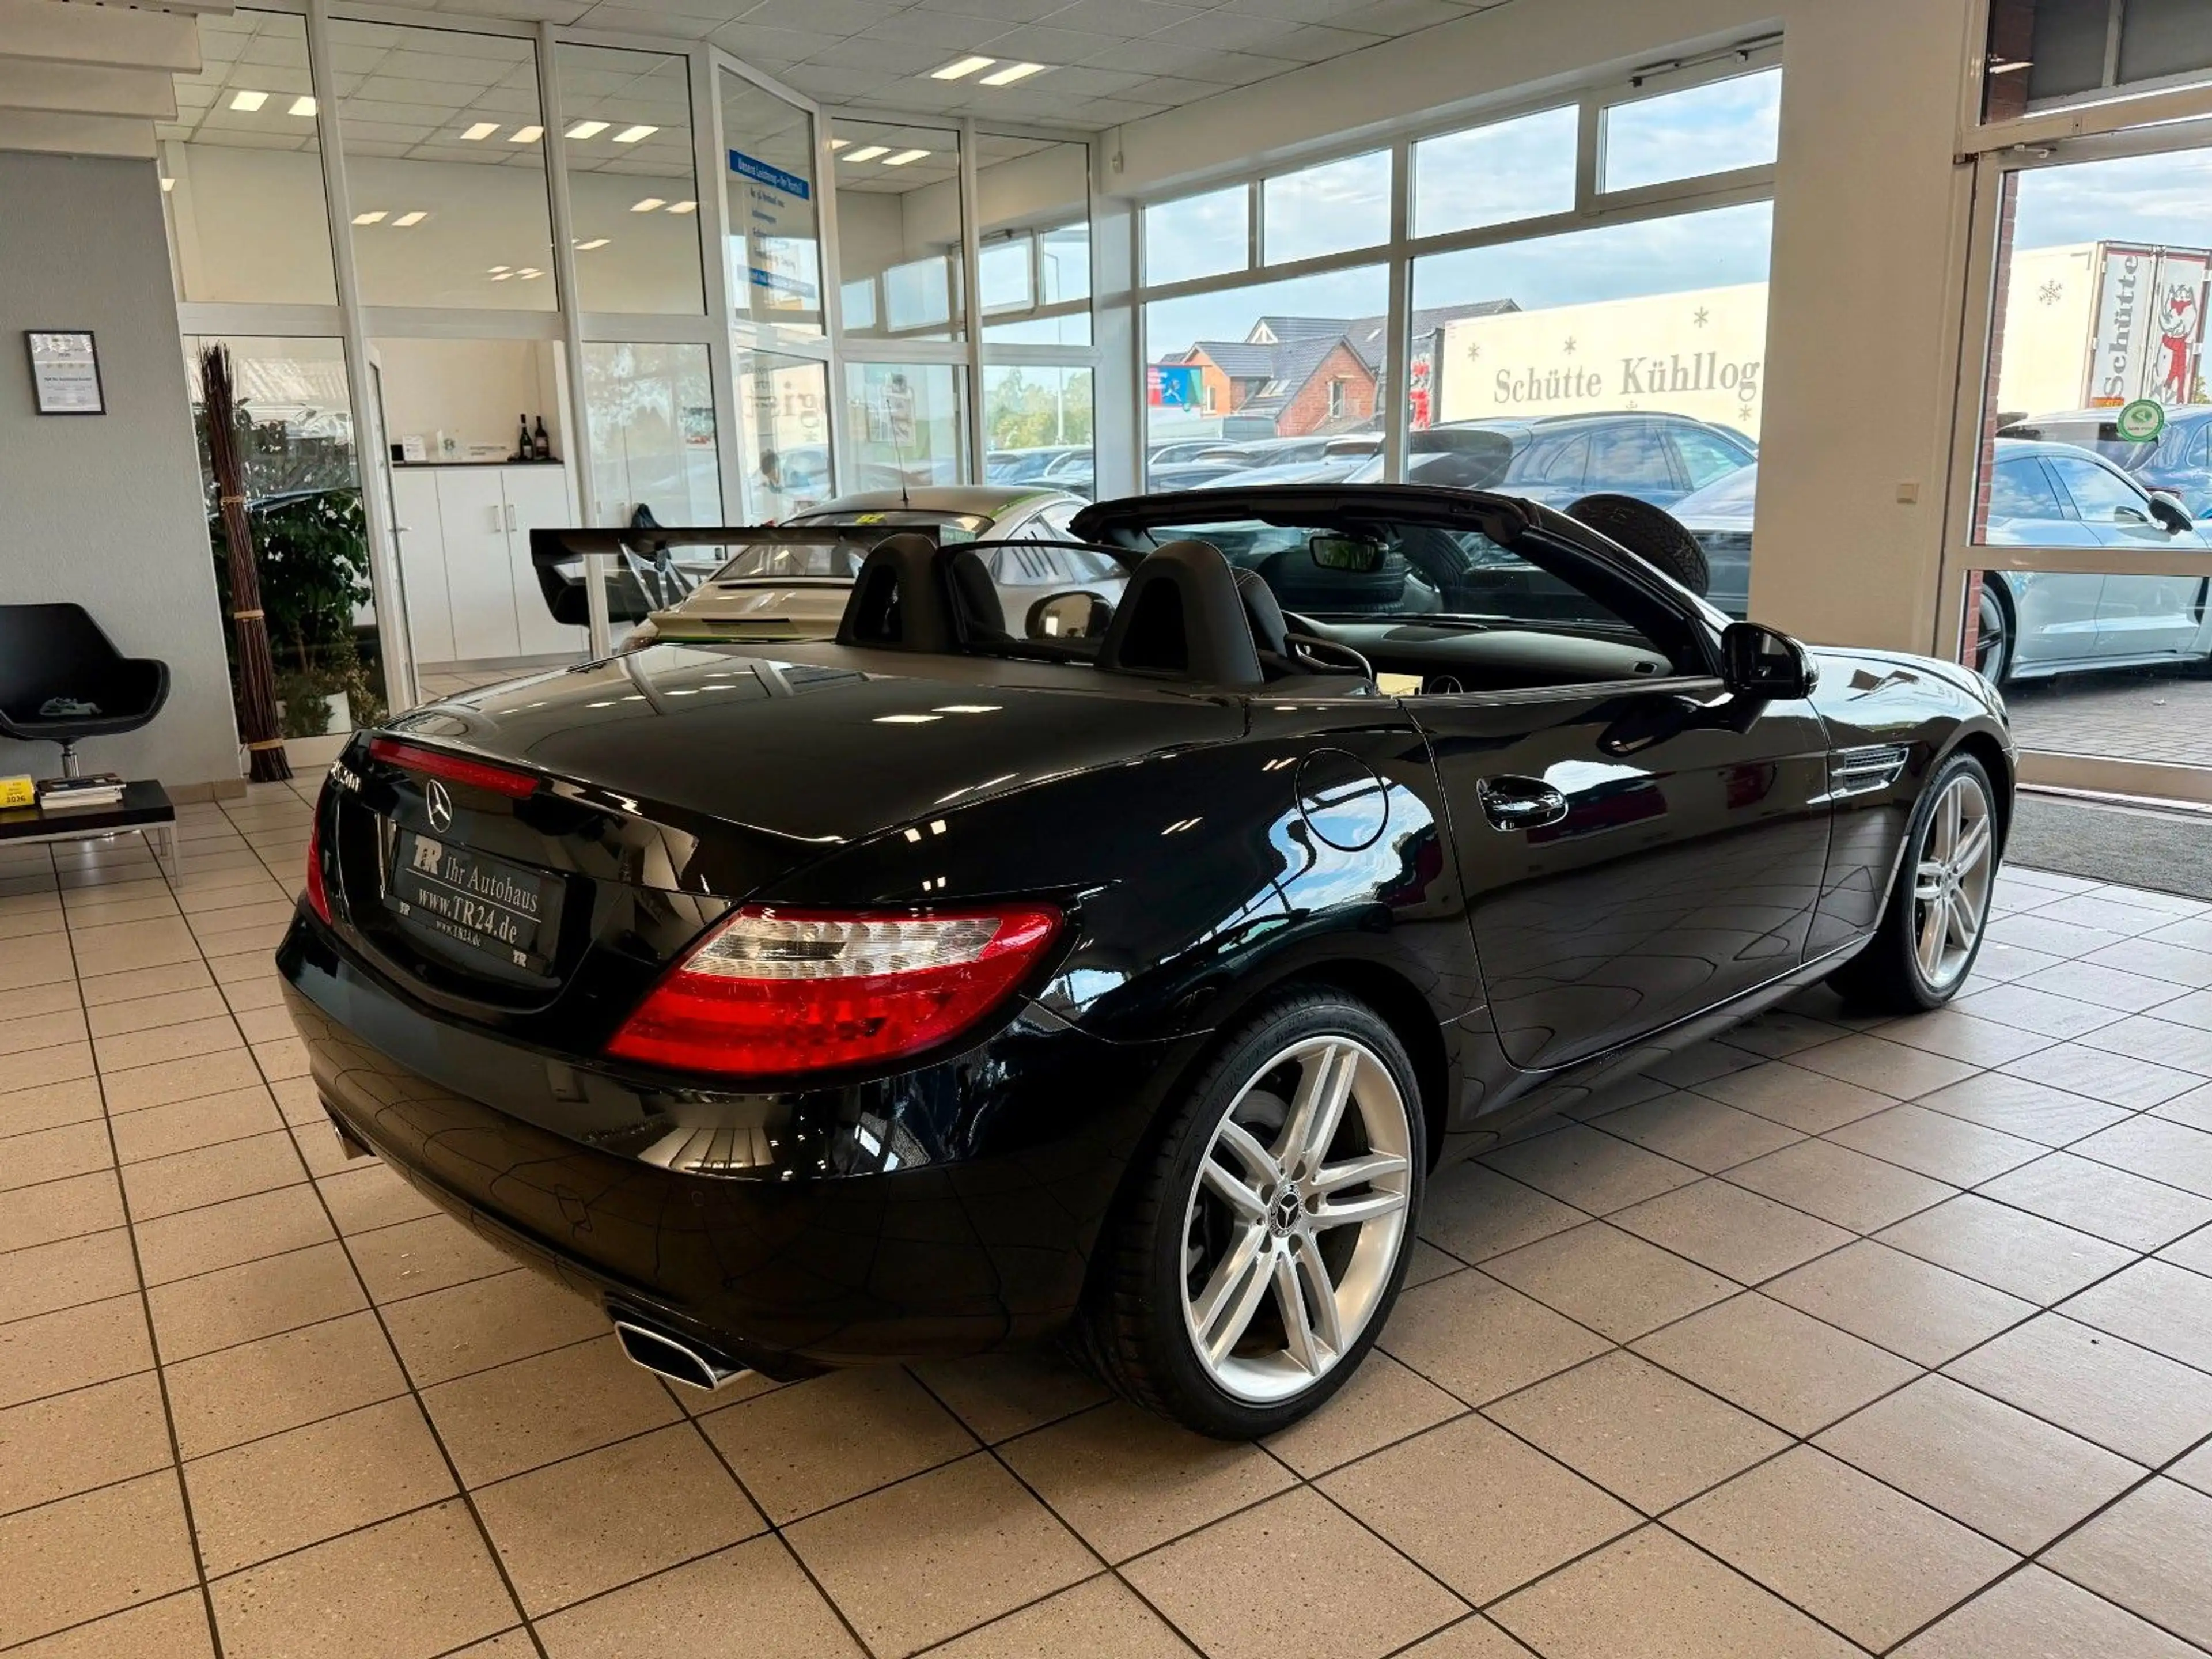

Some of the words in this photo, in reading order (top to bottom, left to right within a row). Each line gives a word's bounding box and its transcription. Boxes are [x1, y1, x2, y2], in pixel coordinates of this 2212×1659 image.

[2104, 256, 2138, 397] Schütte
[1494, 365, 1601, 403] Schütte
[1619, 351, 1760, 402] Kühllog
[444, 857, 465, 885] Ihr
[468, 866, 537, 912] Autohaus
[418, 888, 517, 944] www.TR24.de
